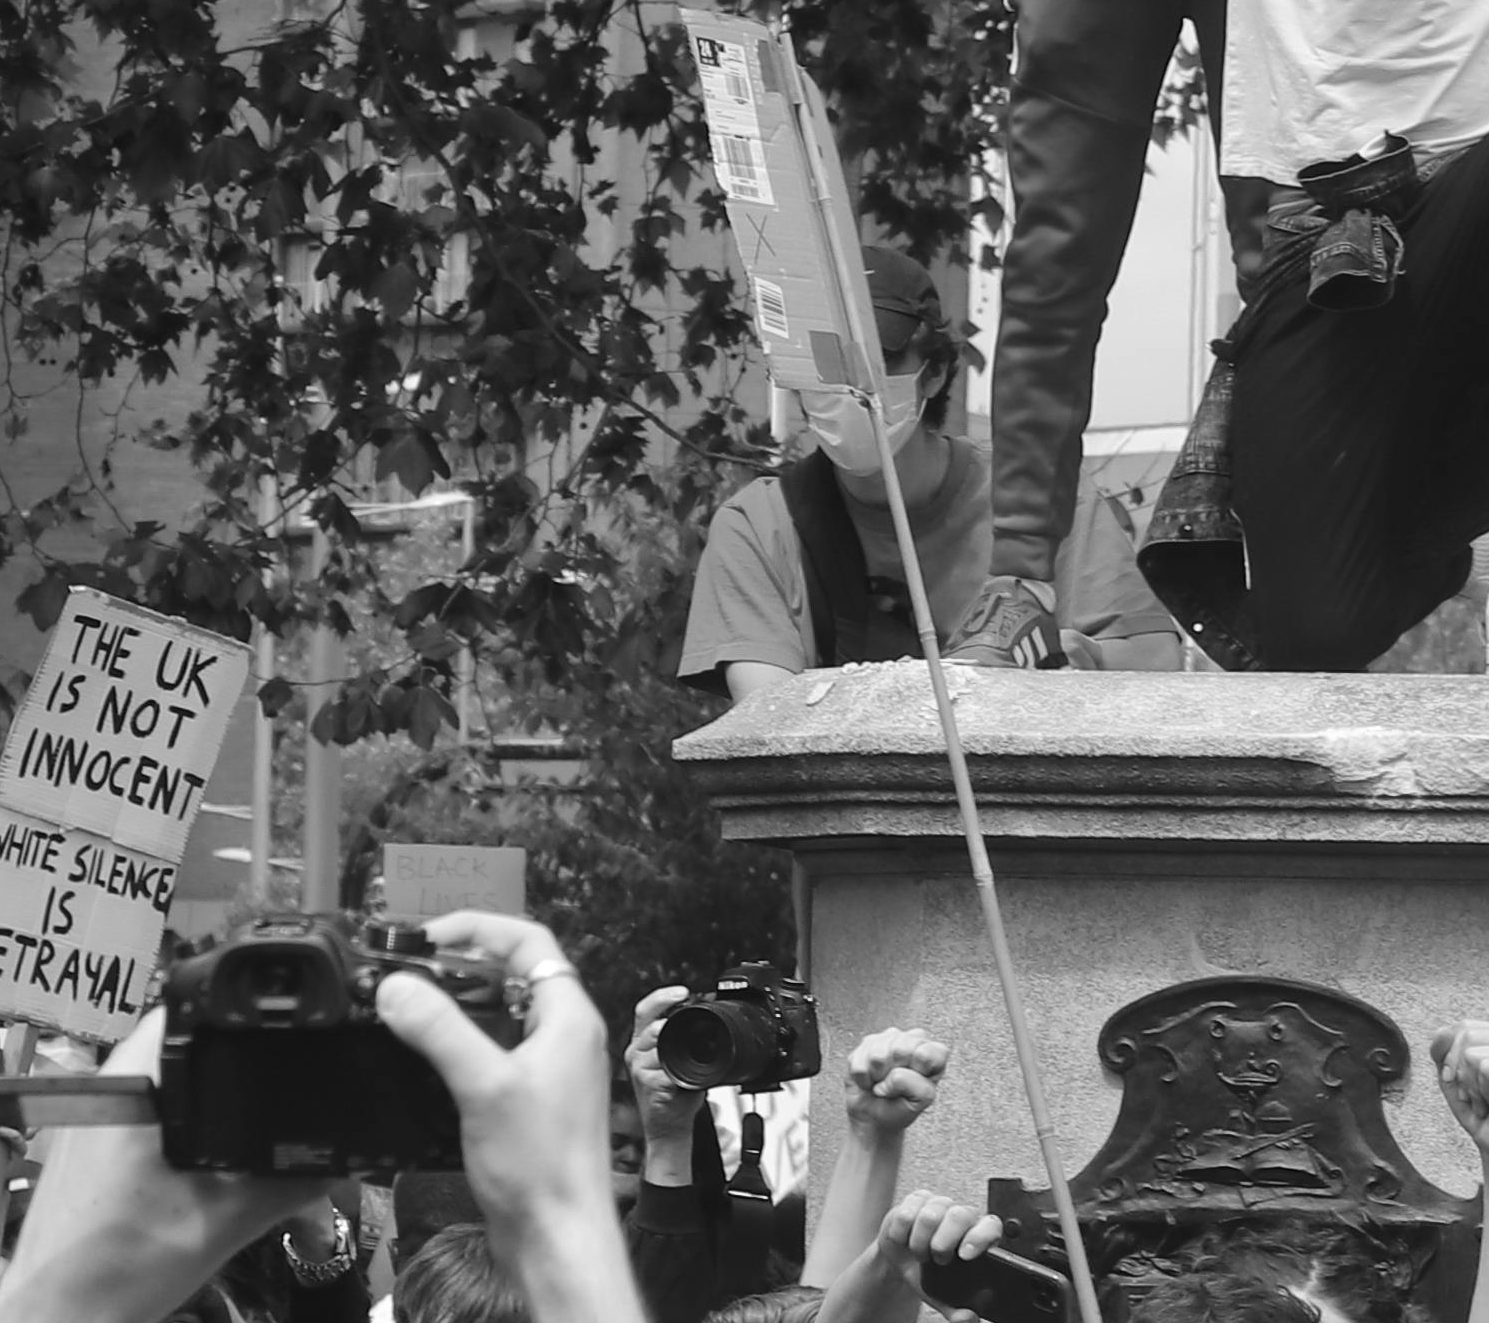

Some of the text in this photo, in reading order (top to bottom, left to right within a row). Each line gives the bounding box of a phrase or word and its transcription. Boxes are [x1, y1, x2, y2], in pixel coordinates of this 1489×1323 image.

[73, 614, 218, 706] THE UK
[46, 670, 195, 750] IS NOT
[18, 727, 206, 822] INNOCENT
[42, 885, 74, 936] IS
[72, 842, 174, 912] SILENCE
